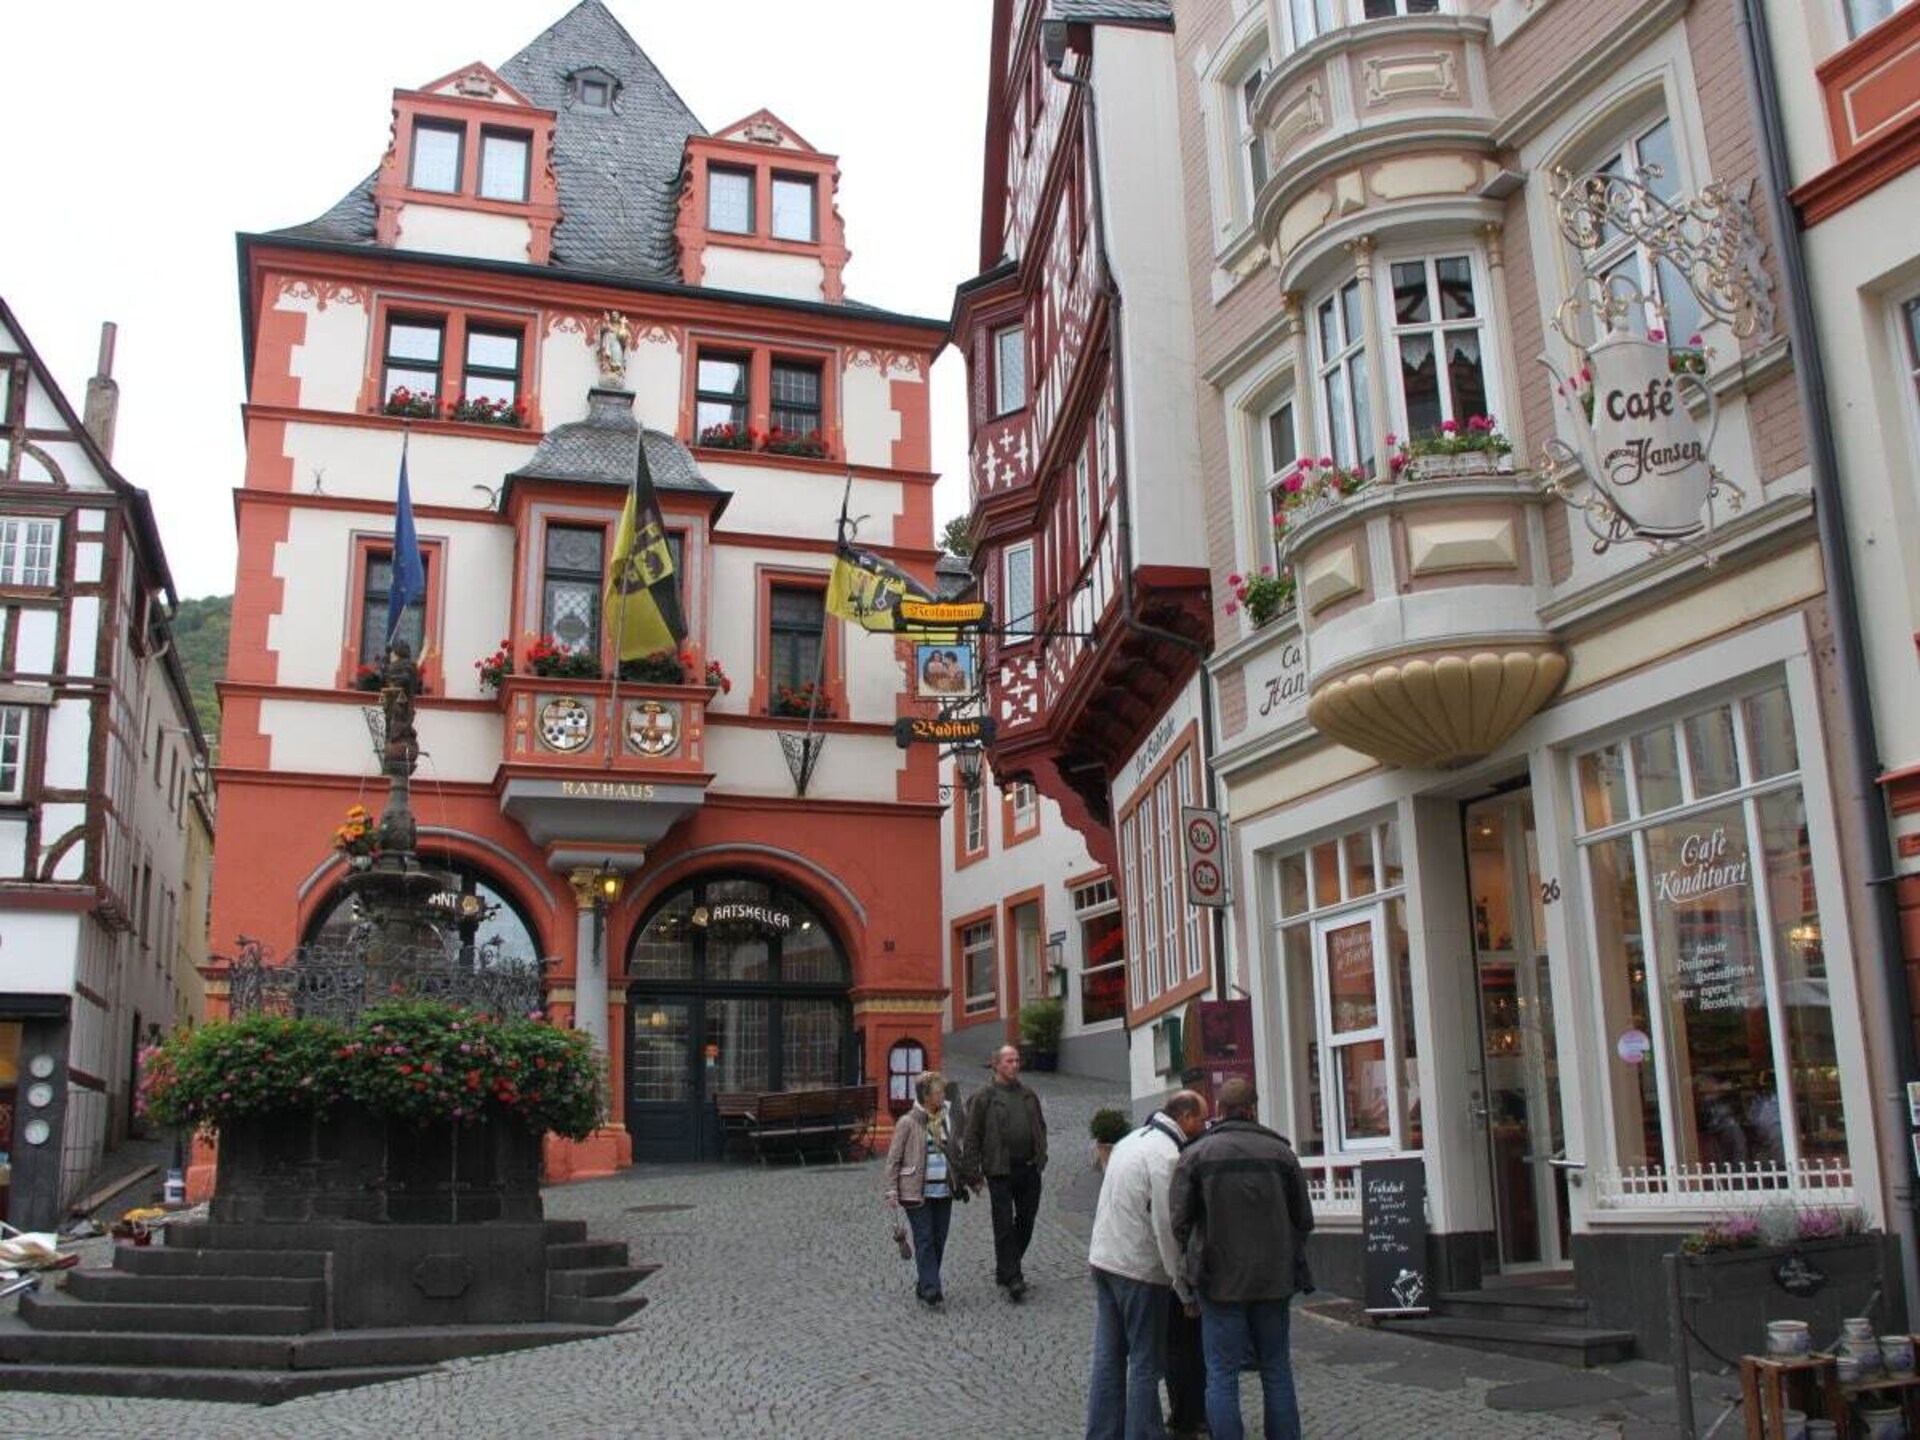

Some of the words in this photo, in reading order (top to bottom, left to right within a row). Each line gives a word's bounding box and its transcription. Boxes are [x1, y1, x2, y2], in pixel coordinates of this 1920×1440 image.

[1606, 378, 1674, 422] Café
[1611, 438, 1706, 485] Hansen
[562, 781, 655, 799] RATHAUS
[1681, 827, 1728, 868] Café
[1541, 877, 1561, 905] 26
[1654, 852, 1748, 903] Konditorei
[712, 904, 790, 929] RATSKELLER
